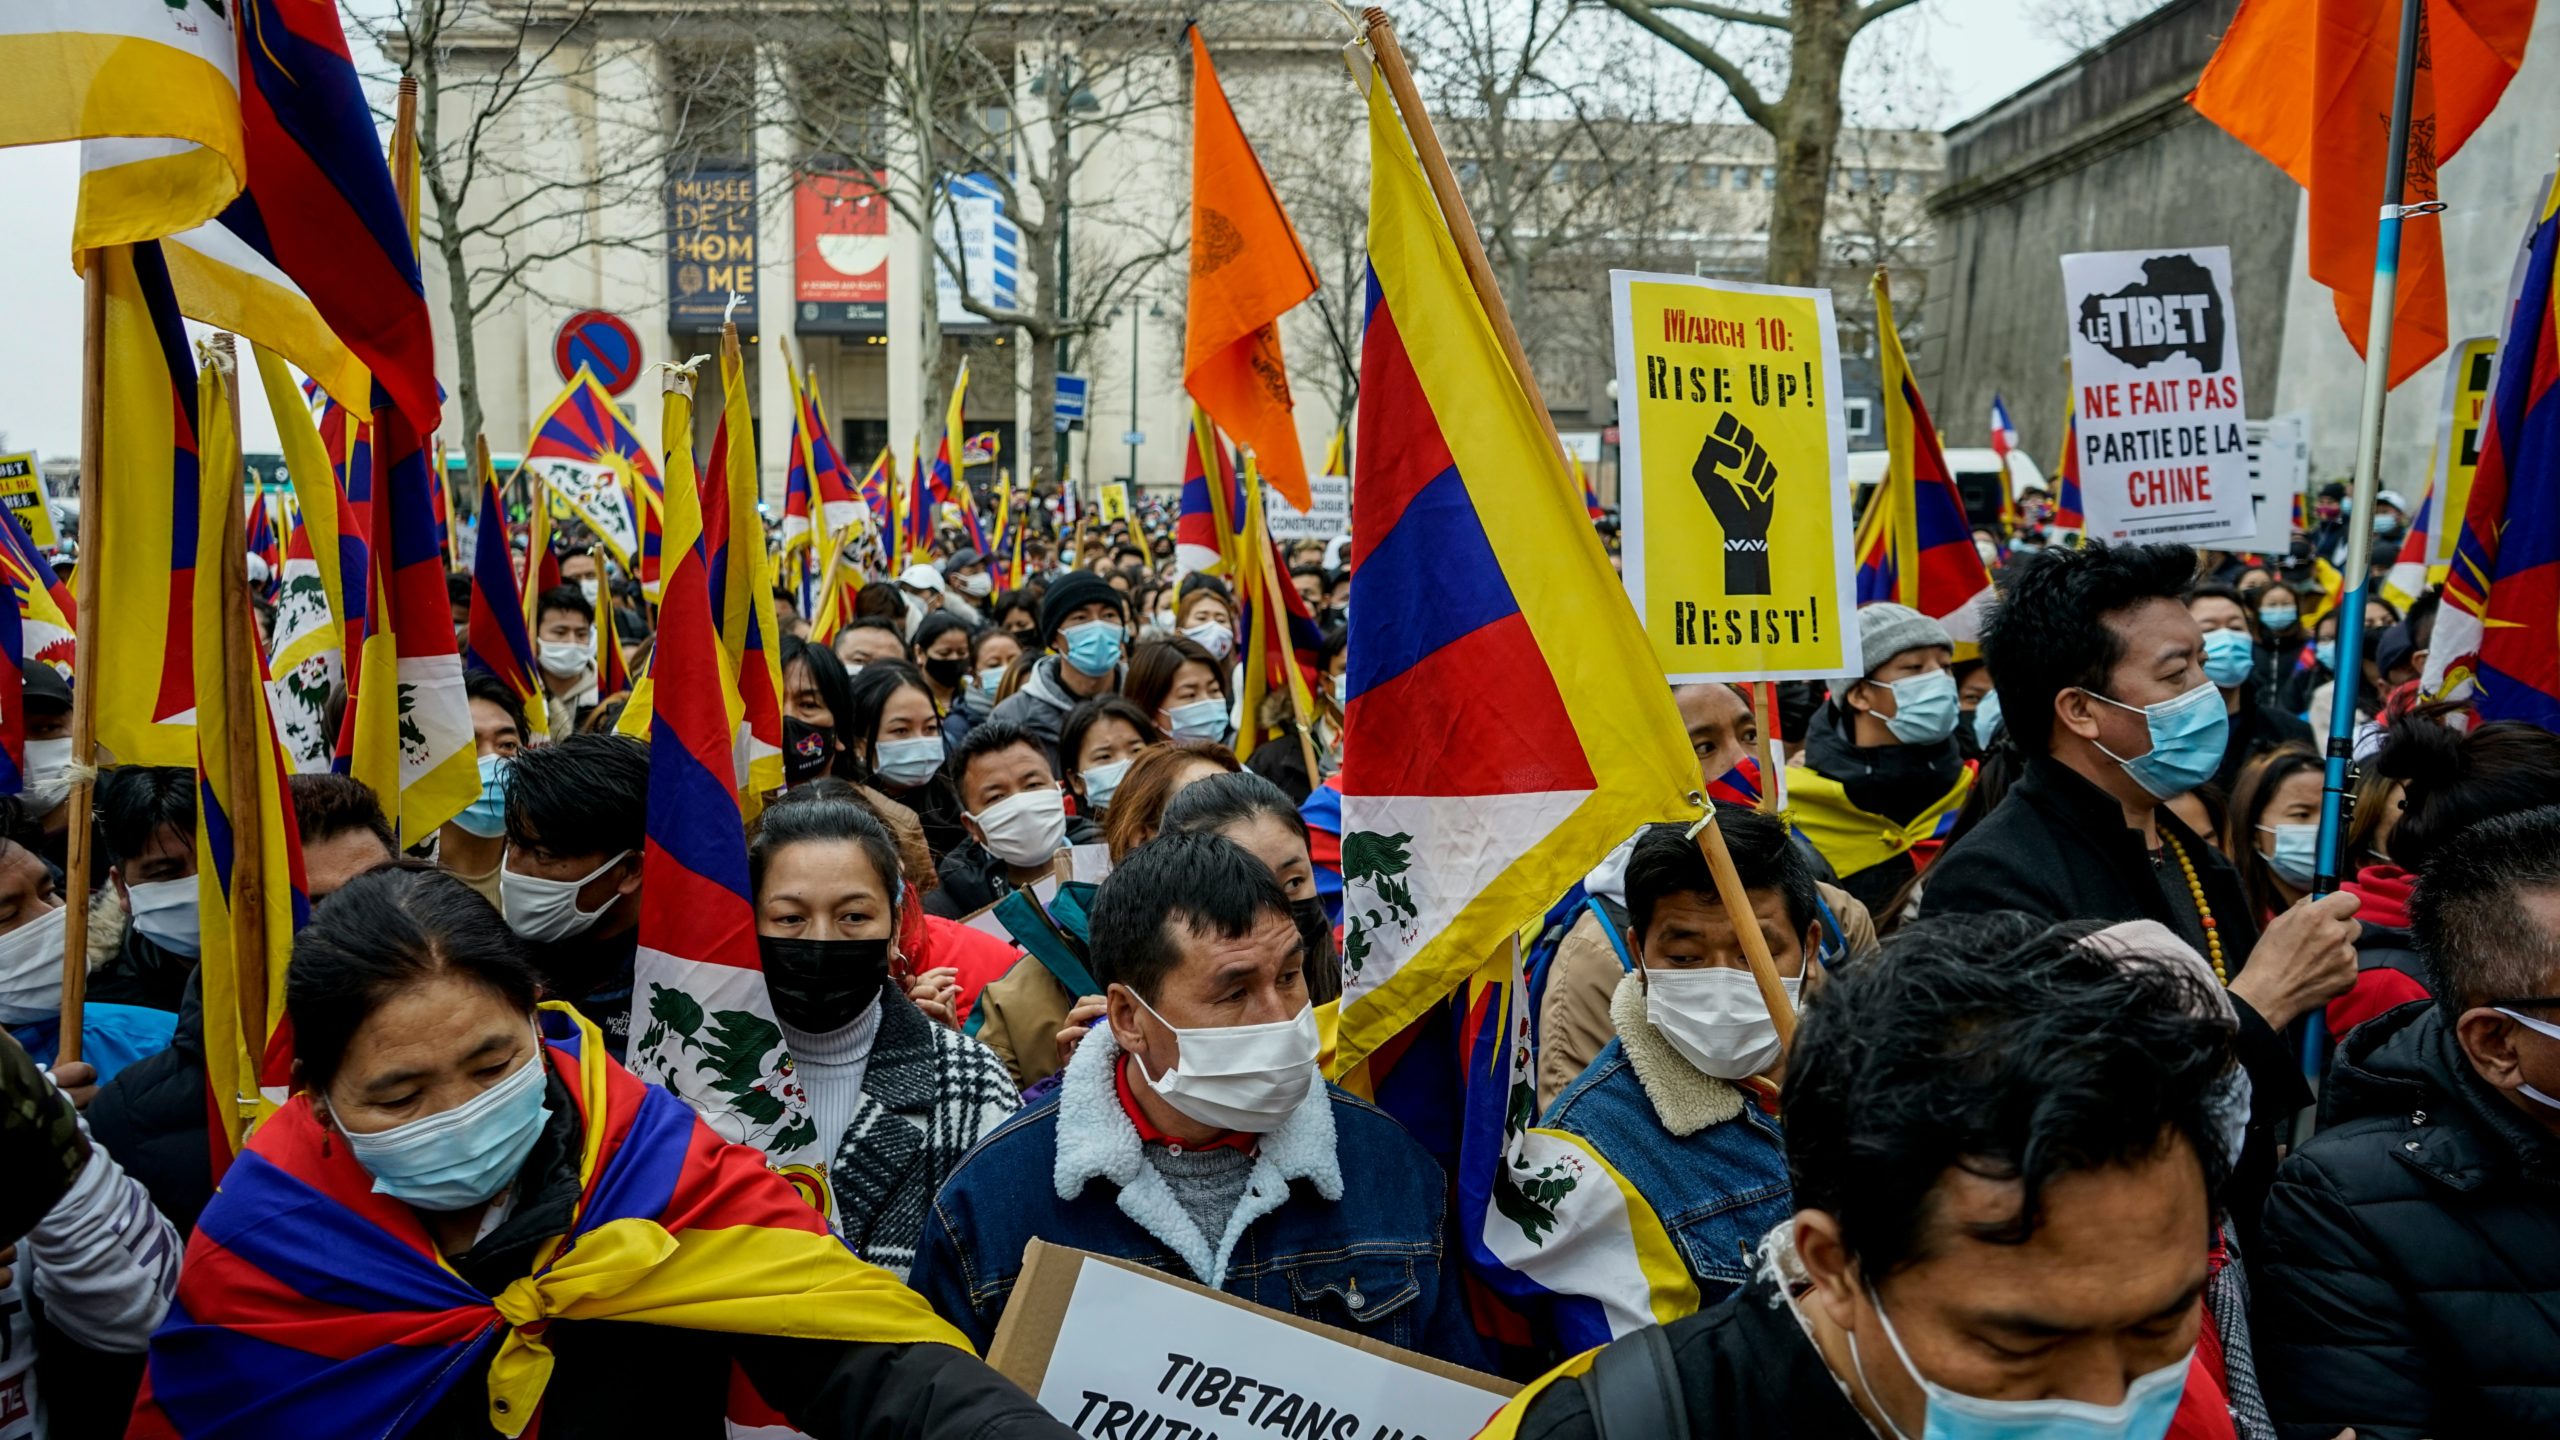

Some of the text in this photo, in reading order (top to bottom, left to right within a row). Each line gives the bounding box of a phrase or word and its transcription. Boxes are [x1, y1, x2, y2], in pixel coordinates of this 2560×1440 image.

[675, 176, 752, 201] MUSÉE
[676, 203, 718, 231] DE
[676, 234, 753, 262] HOM
[707, 265, 754, 293] ME
[1663, 308, 1794, 352] MARCH 10:
[2086, 294, 2210, 348] LE TIBET
[1647, 355, 1814, 408] RISE UP!
[2084, 376, 2238, 419] NE FAIT PAS
[2086, 423, 2243, 466] PARTIE DE LA
[2127, 465, 2213, 508] CHINE
[1675, 596, 1820, 646] RESIST!
[1157, 1352, 1360, 1440] TIBETANS
